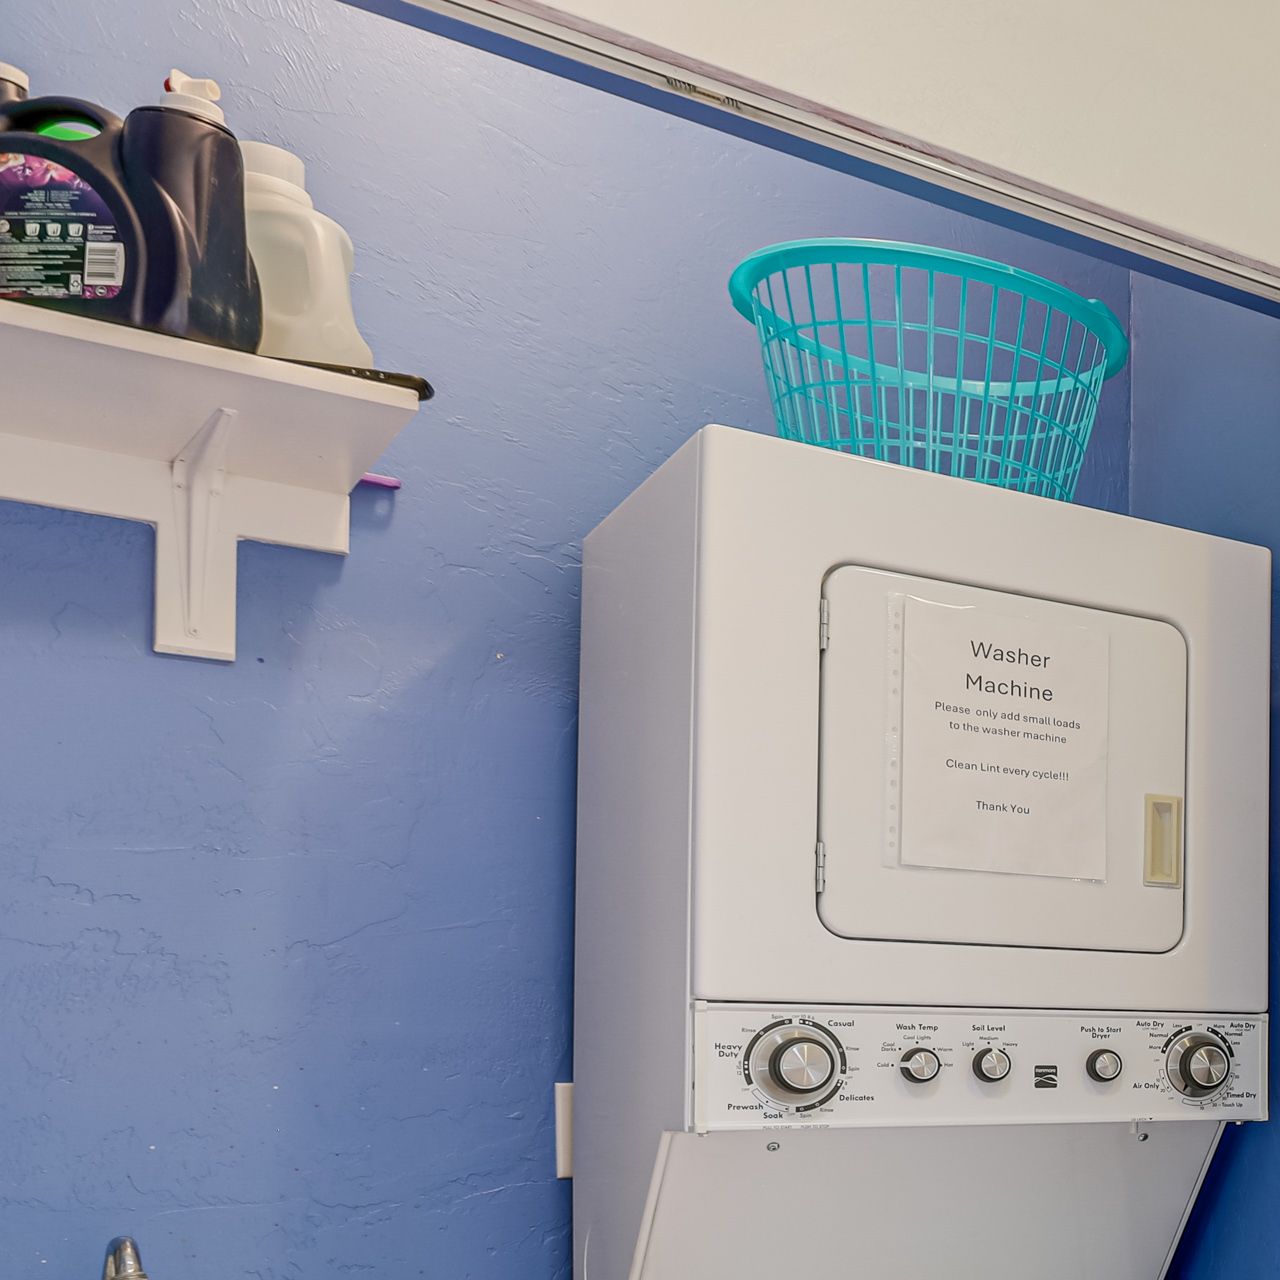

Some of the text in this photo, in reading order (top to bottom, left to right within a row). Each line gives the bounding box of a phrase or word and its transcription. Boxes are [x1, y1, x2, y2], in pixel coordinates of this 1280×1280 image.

[970, 640, 1051, 668] Washer
[965, 673, 1053, 701] Machine
[935, 701, 1081, 730] Please only add small loads
[949, 721, 1067, 744] to the washer machine
[945, 758, 1069, 781] Clean Lint every cycle!!!
[976, 800, 1031, 815] Thank You
[827, 1019, 855, 1027] Casual
[896, 1023, 939, 1032] Wash Temp
[1152, 1020, 1165, 1028] Dry
[1091, 1032, 1111, 1040] Dryer
[714, 1042, 743, 1051] Heavy
[718, 1050, 739, 1058] Duty
[1144, 1082, 1160, 1090] Only
[763, 1111, 784, 1119] Soak
